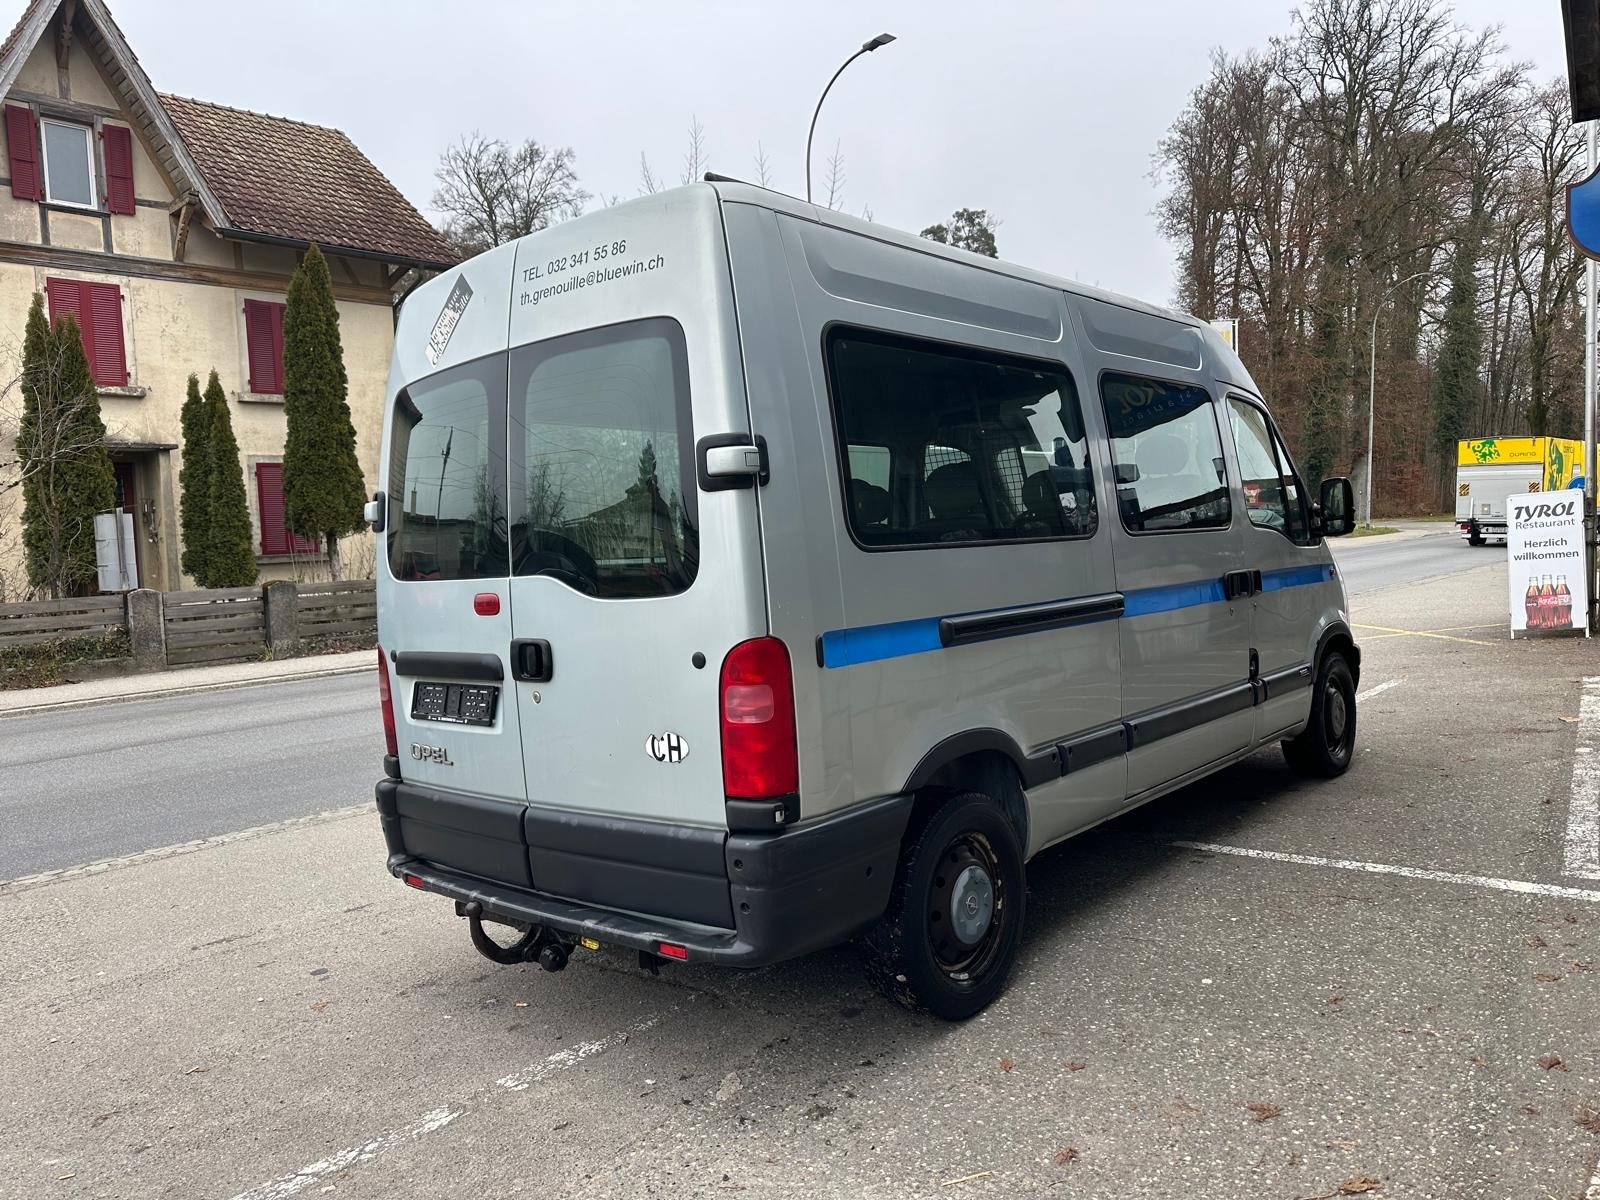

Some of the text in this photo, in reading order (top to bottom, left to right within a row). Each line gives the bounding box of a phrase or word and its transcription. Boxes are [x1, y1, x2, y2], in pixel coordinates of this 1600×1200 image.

[523, 239, 627, 283] TEL. 032 341 55 86
[520, 254, 664, 306] th.grenouille@bluewin.ch
[1514, 501, 1575, 523] TYROL
[1515, 517, 1575, 530] Restaurant
[1524, 537, 1568, 549] Herzlich
[1514, 550, 1579, 561] willkommen
[410, 742, 454, 766] OPEL
[650, 732, 682, 762] CH
